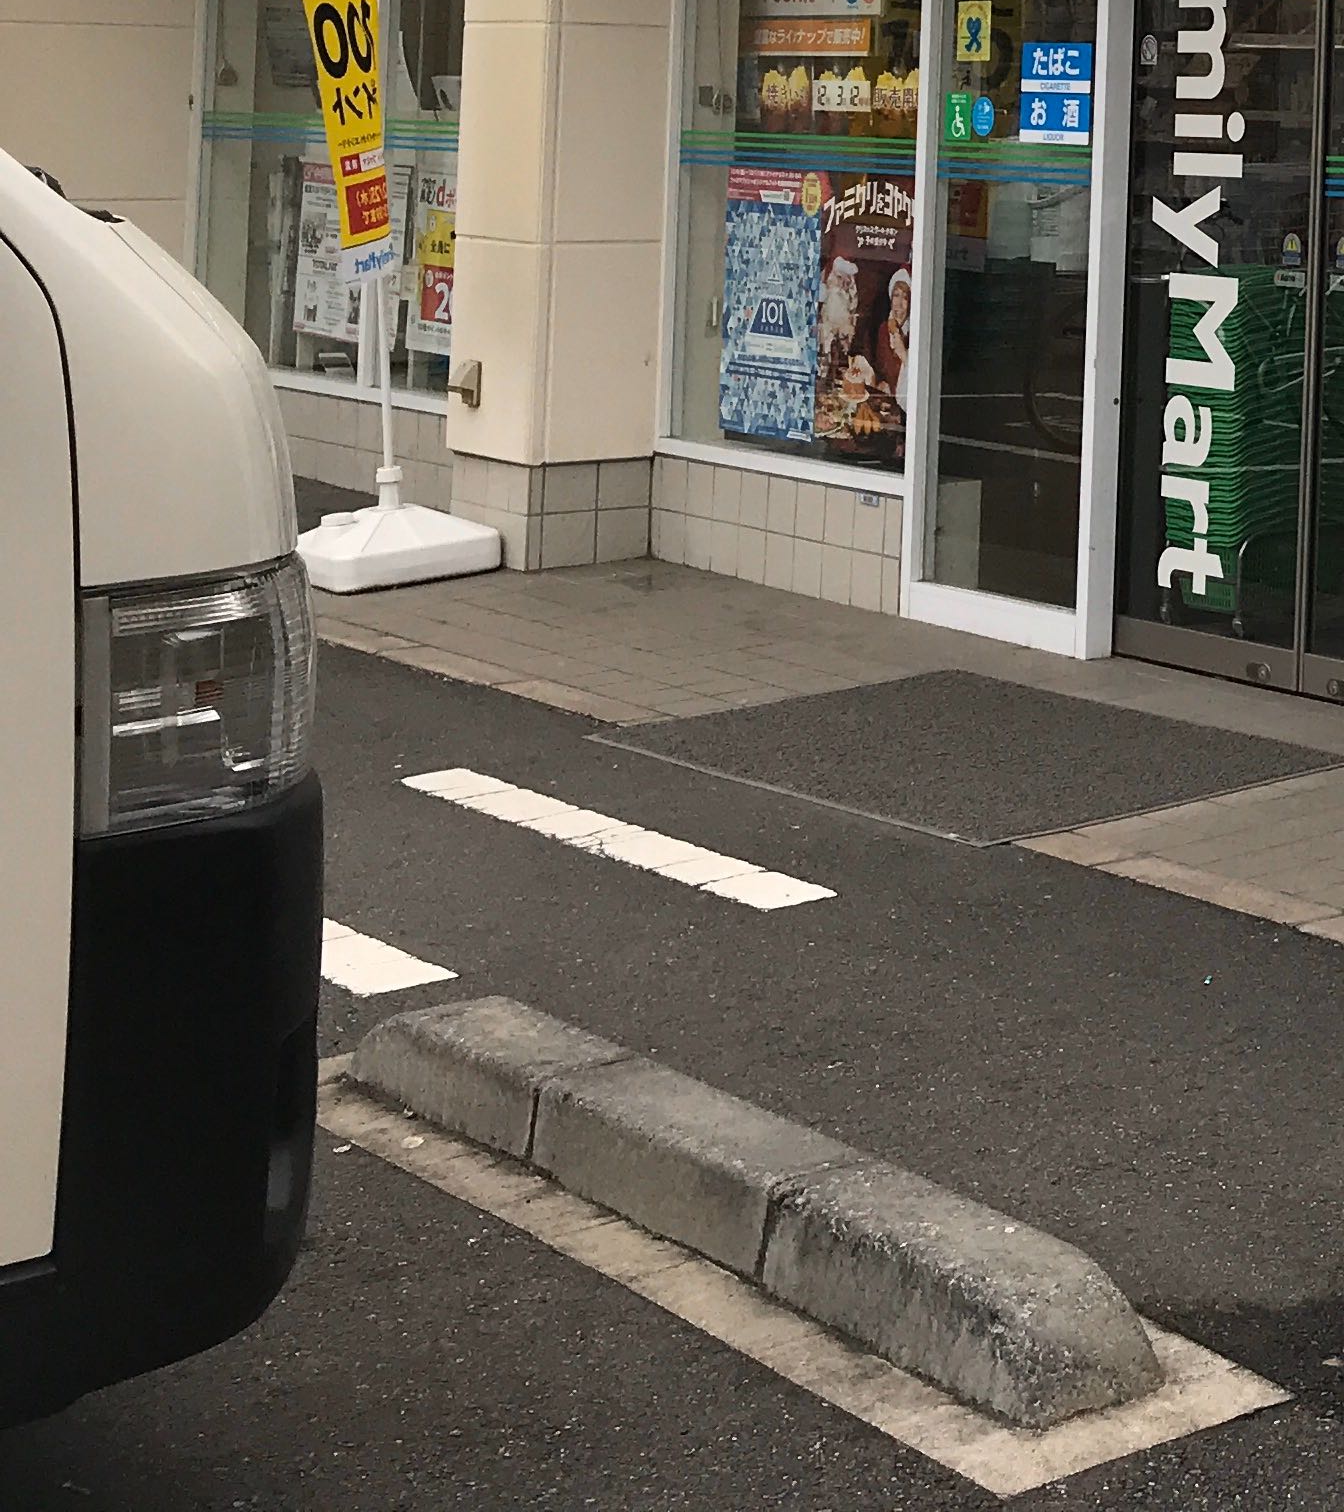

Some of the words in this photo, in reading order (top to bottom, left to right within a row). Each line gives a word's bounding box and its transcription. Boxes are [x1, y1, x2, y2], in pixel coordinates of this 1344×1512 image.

[1032, 47, 1080, 76] たばこ
[761, 302, 784, 326] 101
